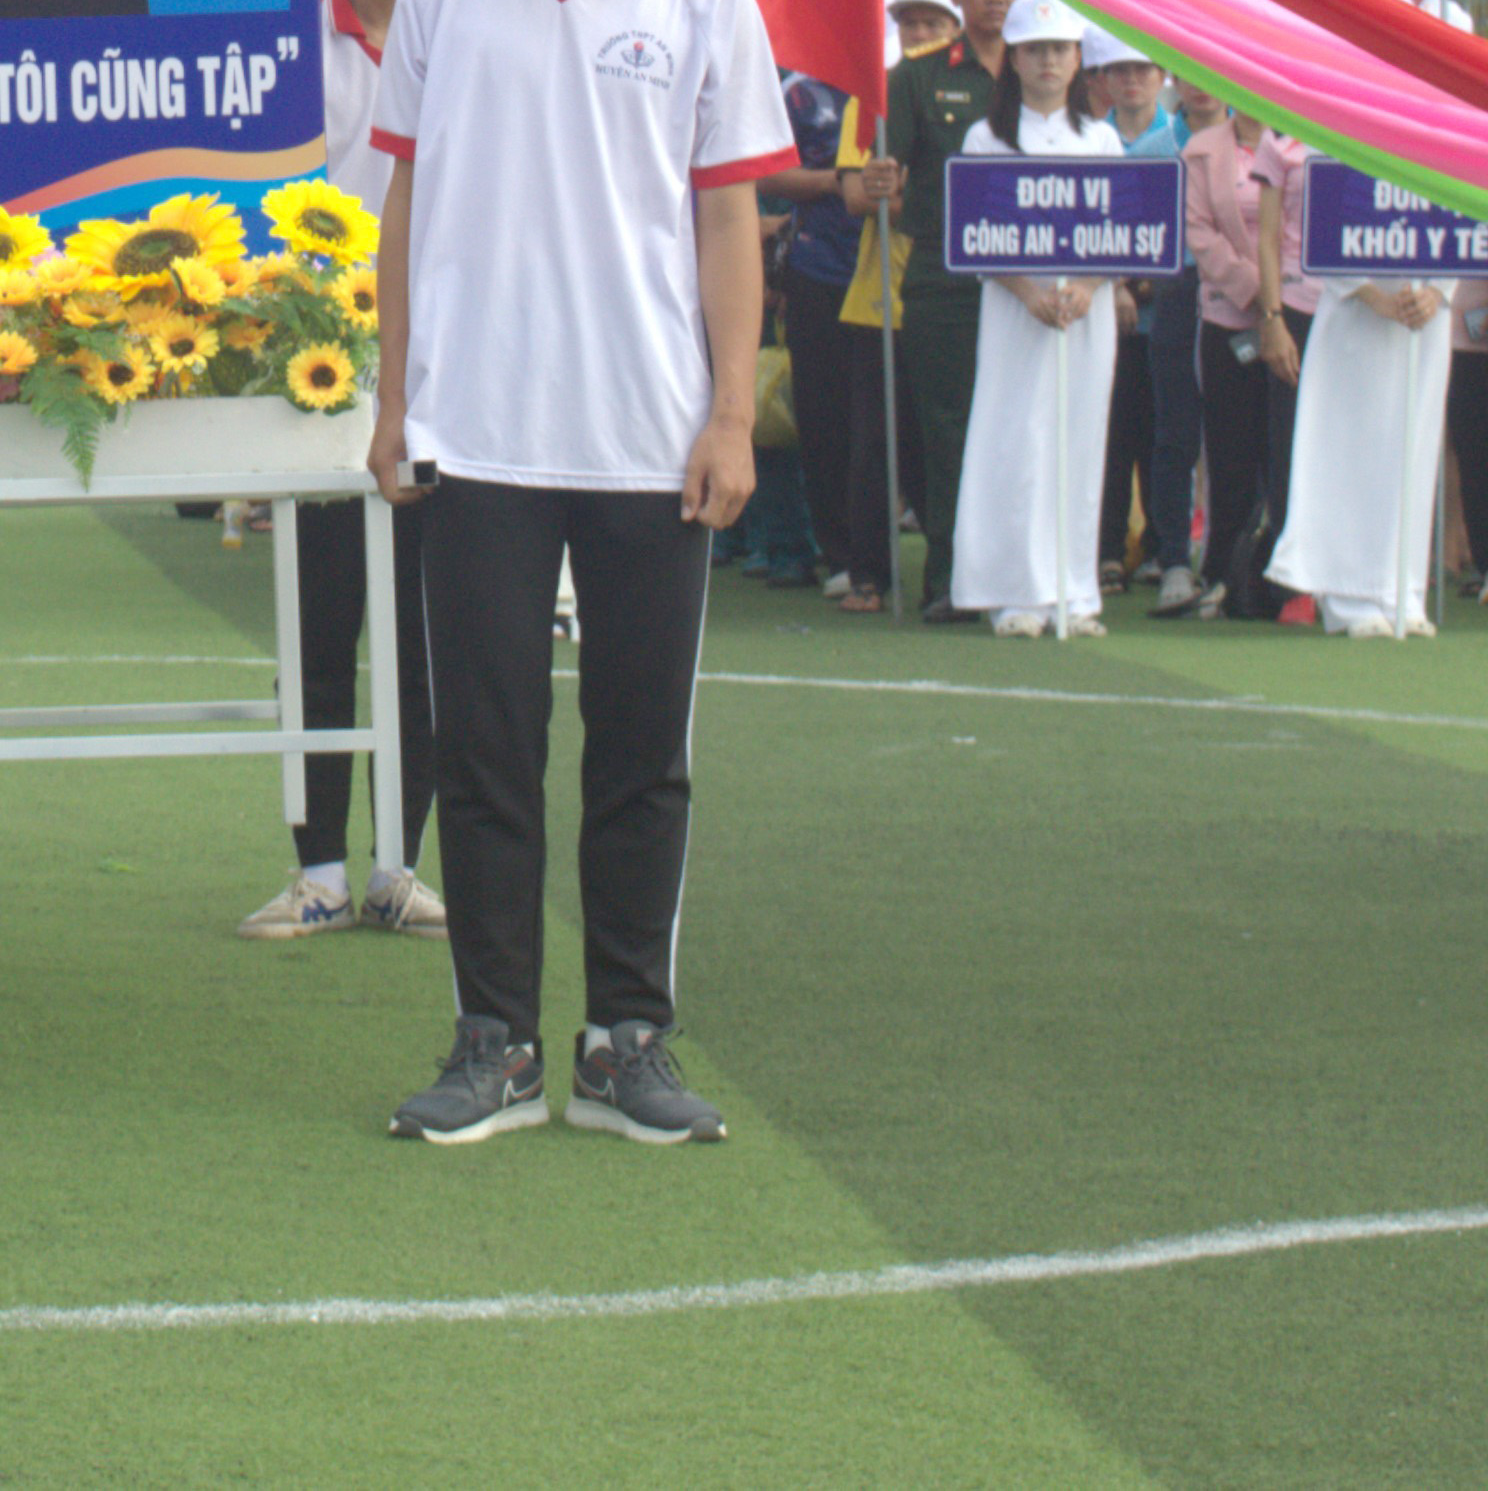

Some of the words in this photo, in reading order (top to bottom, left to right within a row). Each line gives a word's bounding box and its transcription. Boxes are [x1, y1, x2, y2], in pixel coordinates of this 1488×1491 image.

[70, 47, 186, 123] CŨNG
[1016, 174, 1076, 208] ĐƠN
[1082, 176, 1111, 215] VỊ
[962, 217, 1020, 256] CÔNG
[1025, 224, 1056, 256] AN
[1073, 218, 1131, 259] QUÂN
[1135, 221, 1167, 263] SỰ
[1341, 216, 1418, 258] KHỐI
[1426, 226, 1446, 259] Y
